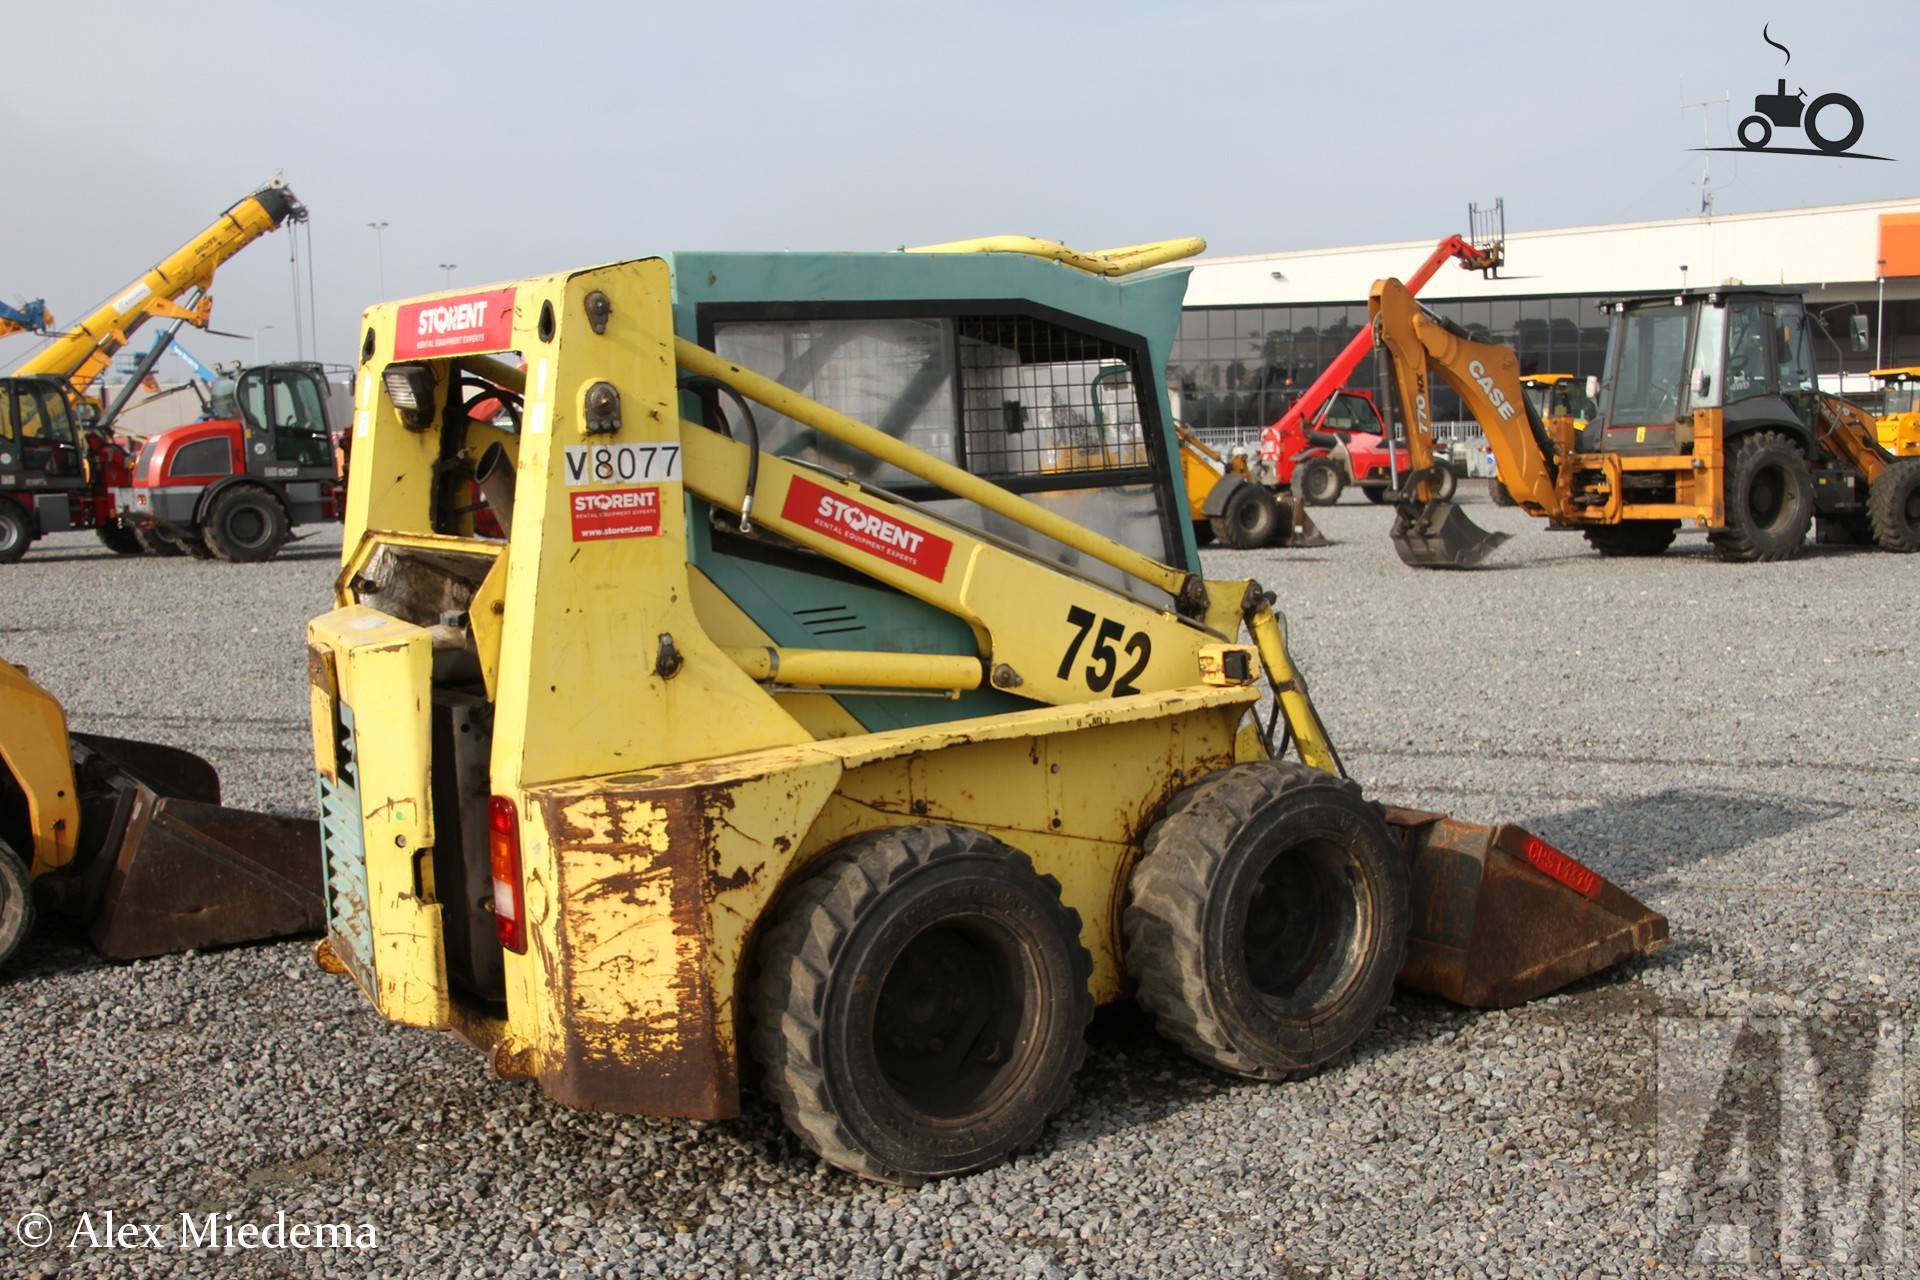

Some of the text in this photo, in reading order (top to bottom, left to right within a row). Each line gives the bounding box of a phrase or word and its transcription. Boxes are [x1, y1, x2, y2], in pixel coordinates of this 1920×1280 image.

[417, 300, 488, 335] STORENT
[1468, 360, 1516, 421] CASE
[575, 491, 656, 511] STORENT
[575, 508, 657, 520] RENTAL EQUIPMENT EXPERTS
[581, 525, 653, 537] www.storent.com
[814, 517, 918, 566] RENTAL EQUIPMENT EXPERTS
[817, 495, 924, 554] STORENT
[1056, 604, 1152, 698] 752
